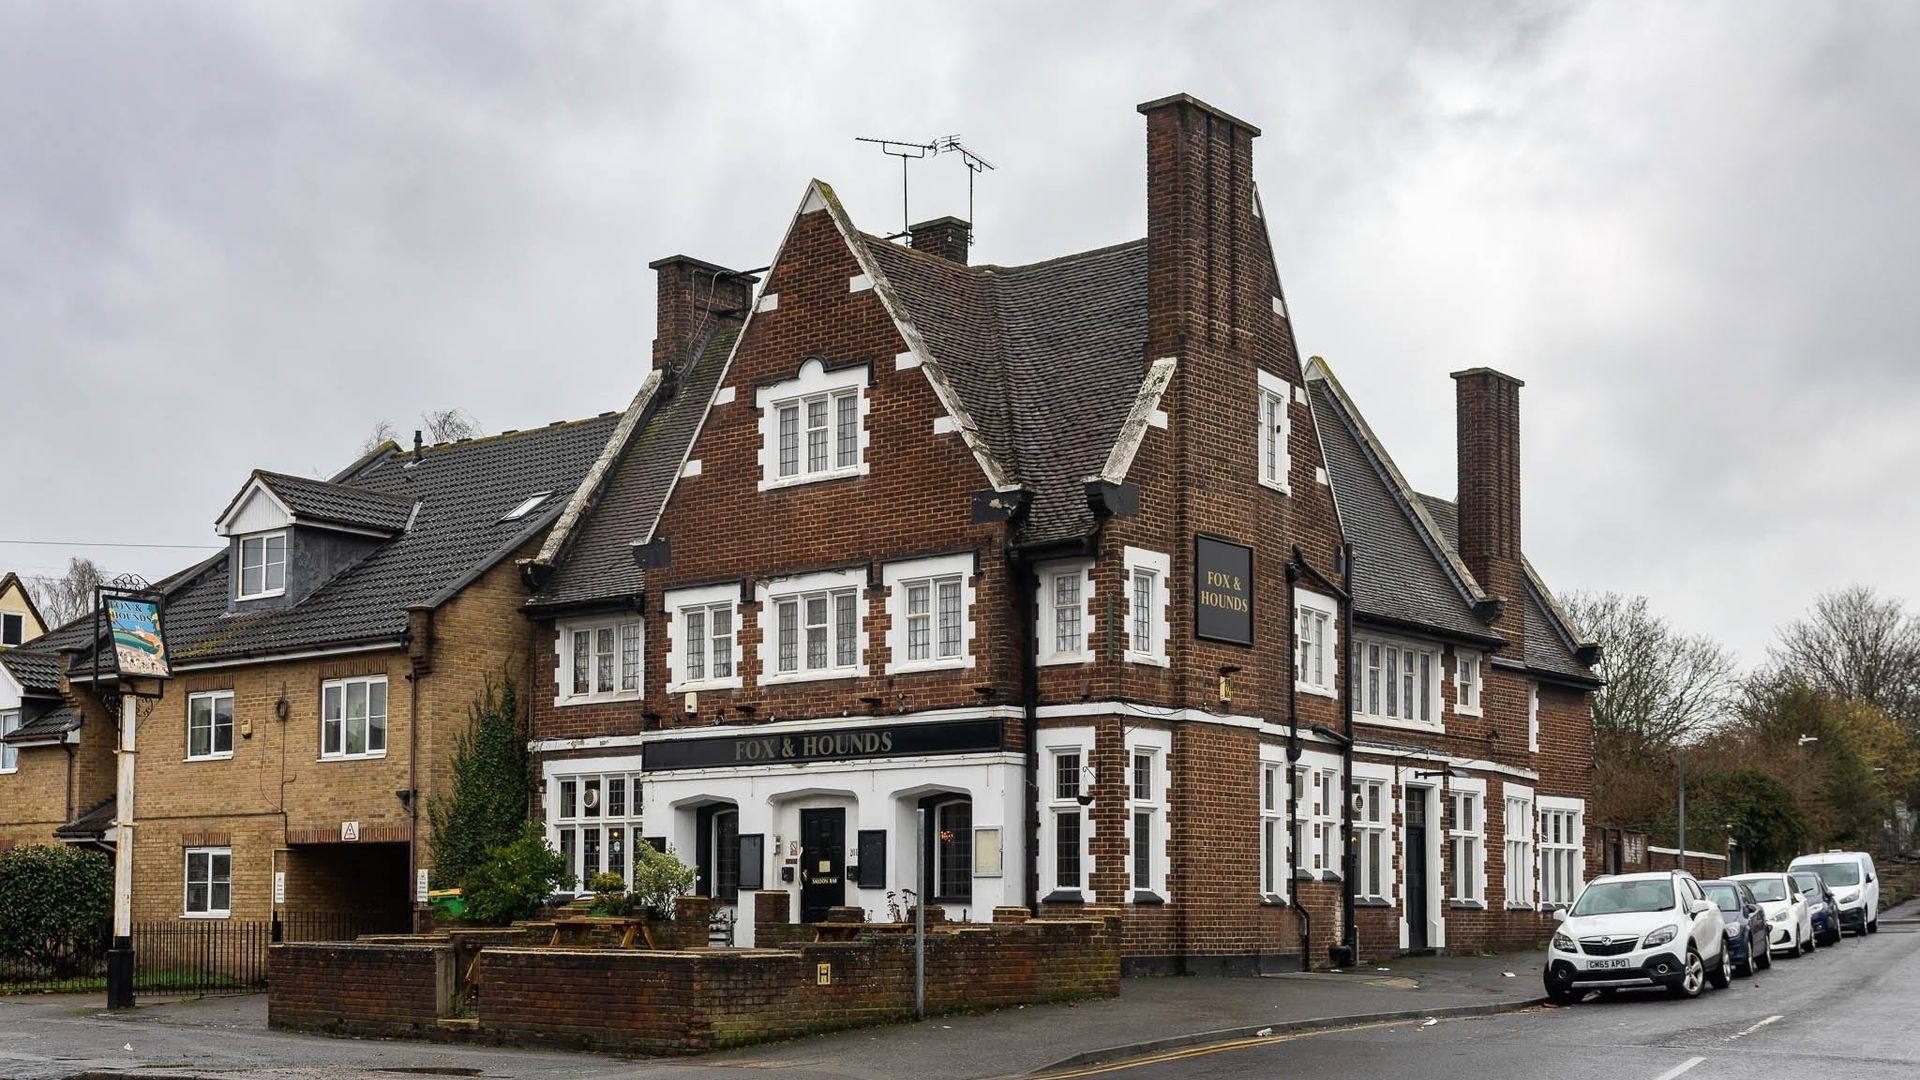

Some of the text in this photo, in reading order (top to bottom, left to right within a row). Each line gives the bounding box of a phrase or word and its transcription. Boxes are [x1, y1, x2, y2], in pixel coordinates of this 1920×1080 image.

[1207, 571, 1242, 590] FOX &
[135, 603, 143, 612] &
[1201, 590, 1248, 612] HOUNDS
[112, 611, 152, 622] HOUNDS
[735, 731, 893, 760] FOX & HOUNDS
